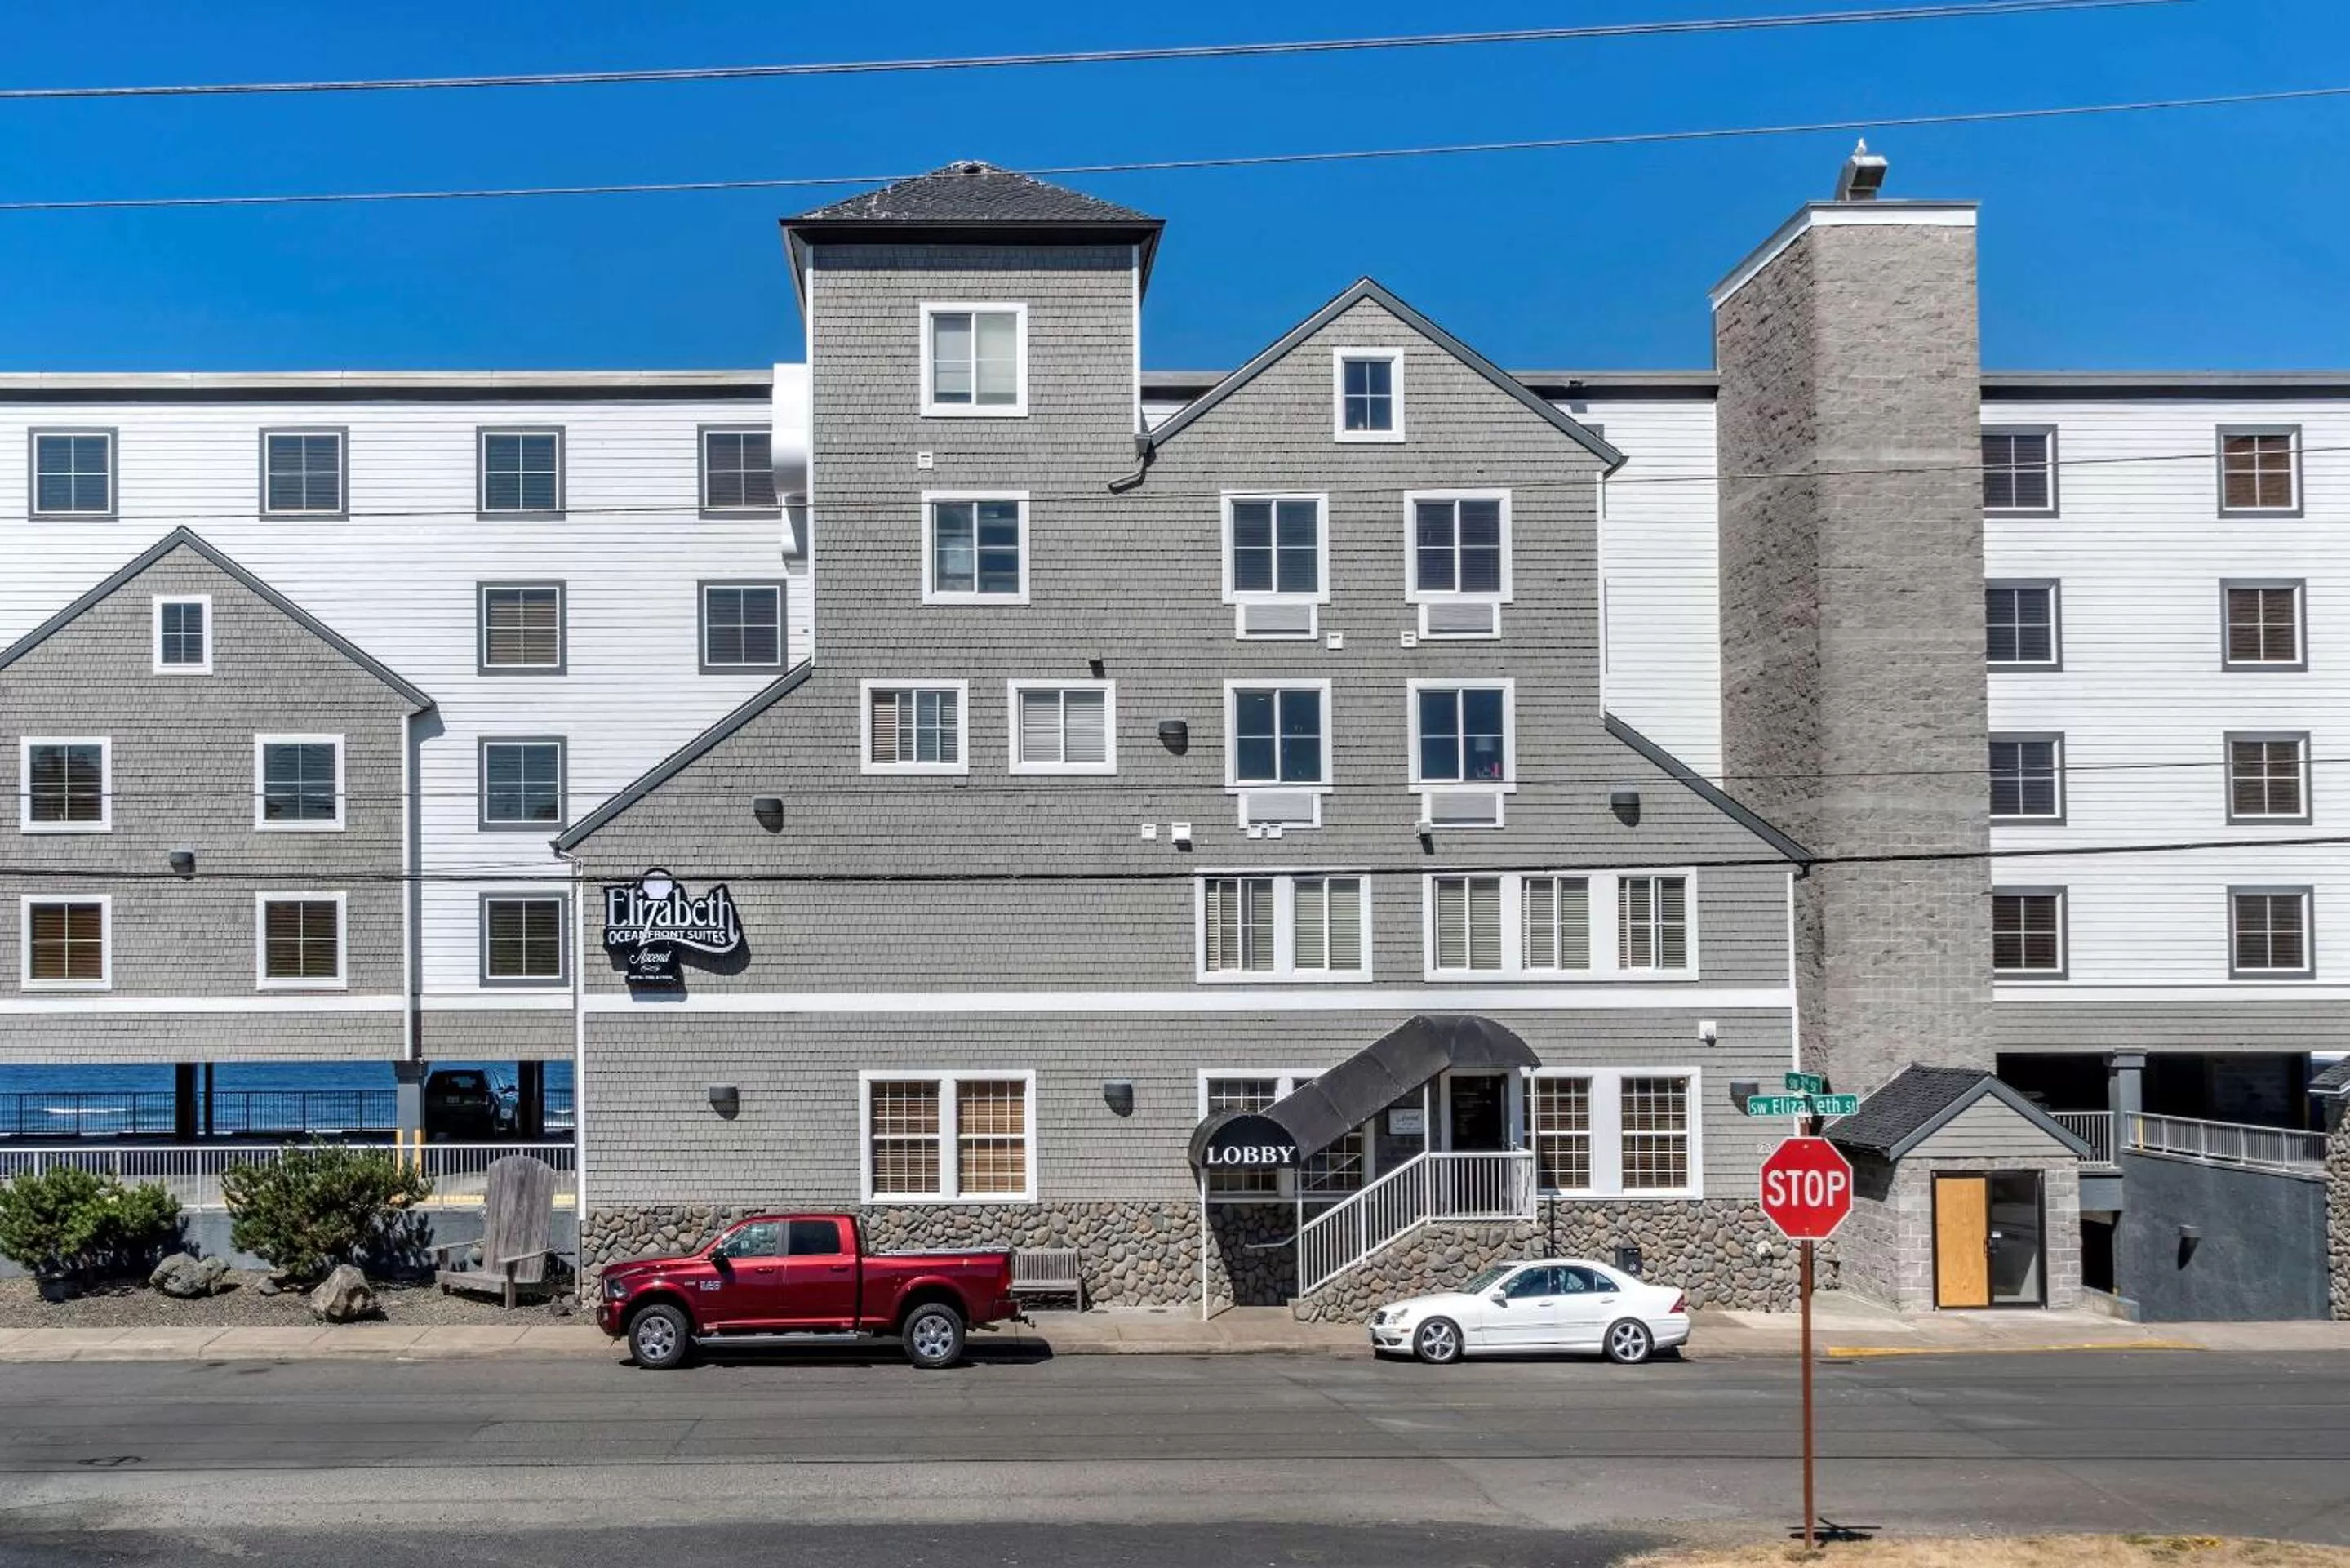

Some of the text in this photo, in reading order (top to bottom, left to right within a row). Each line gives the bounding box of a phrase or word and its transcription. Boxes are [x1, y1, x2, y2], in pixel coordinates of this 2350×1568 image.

[606, 887, 740, 947] Elizabeth
[609, 930, 726, 944] OCEANFRONT SUITES
[629, 948, 672, 964] Ascend
[1206, 1145, 1295, 1164] LOBBY
[1767, 1170, 1846, 1207] STOP
